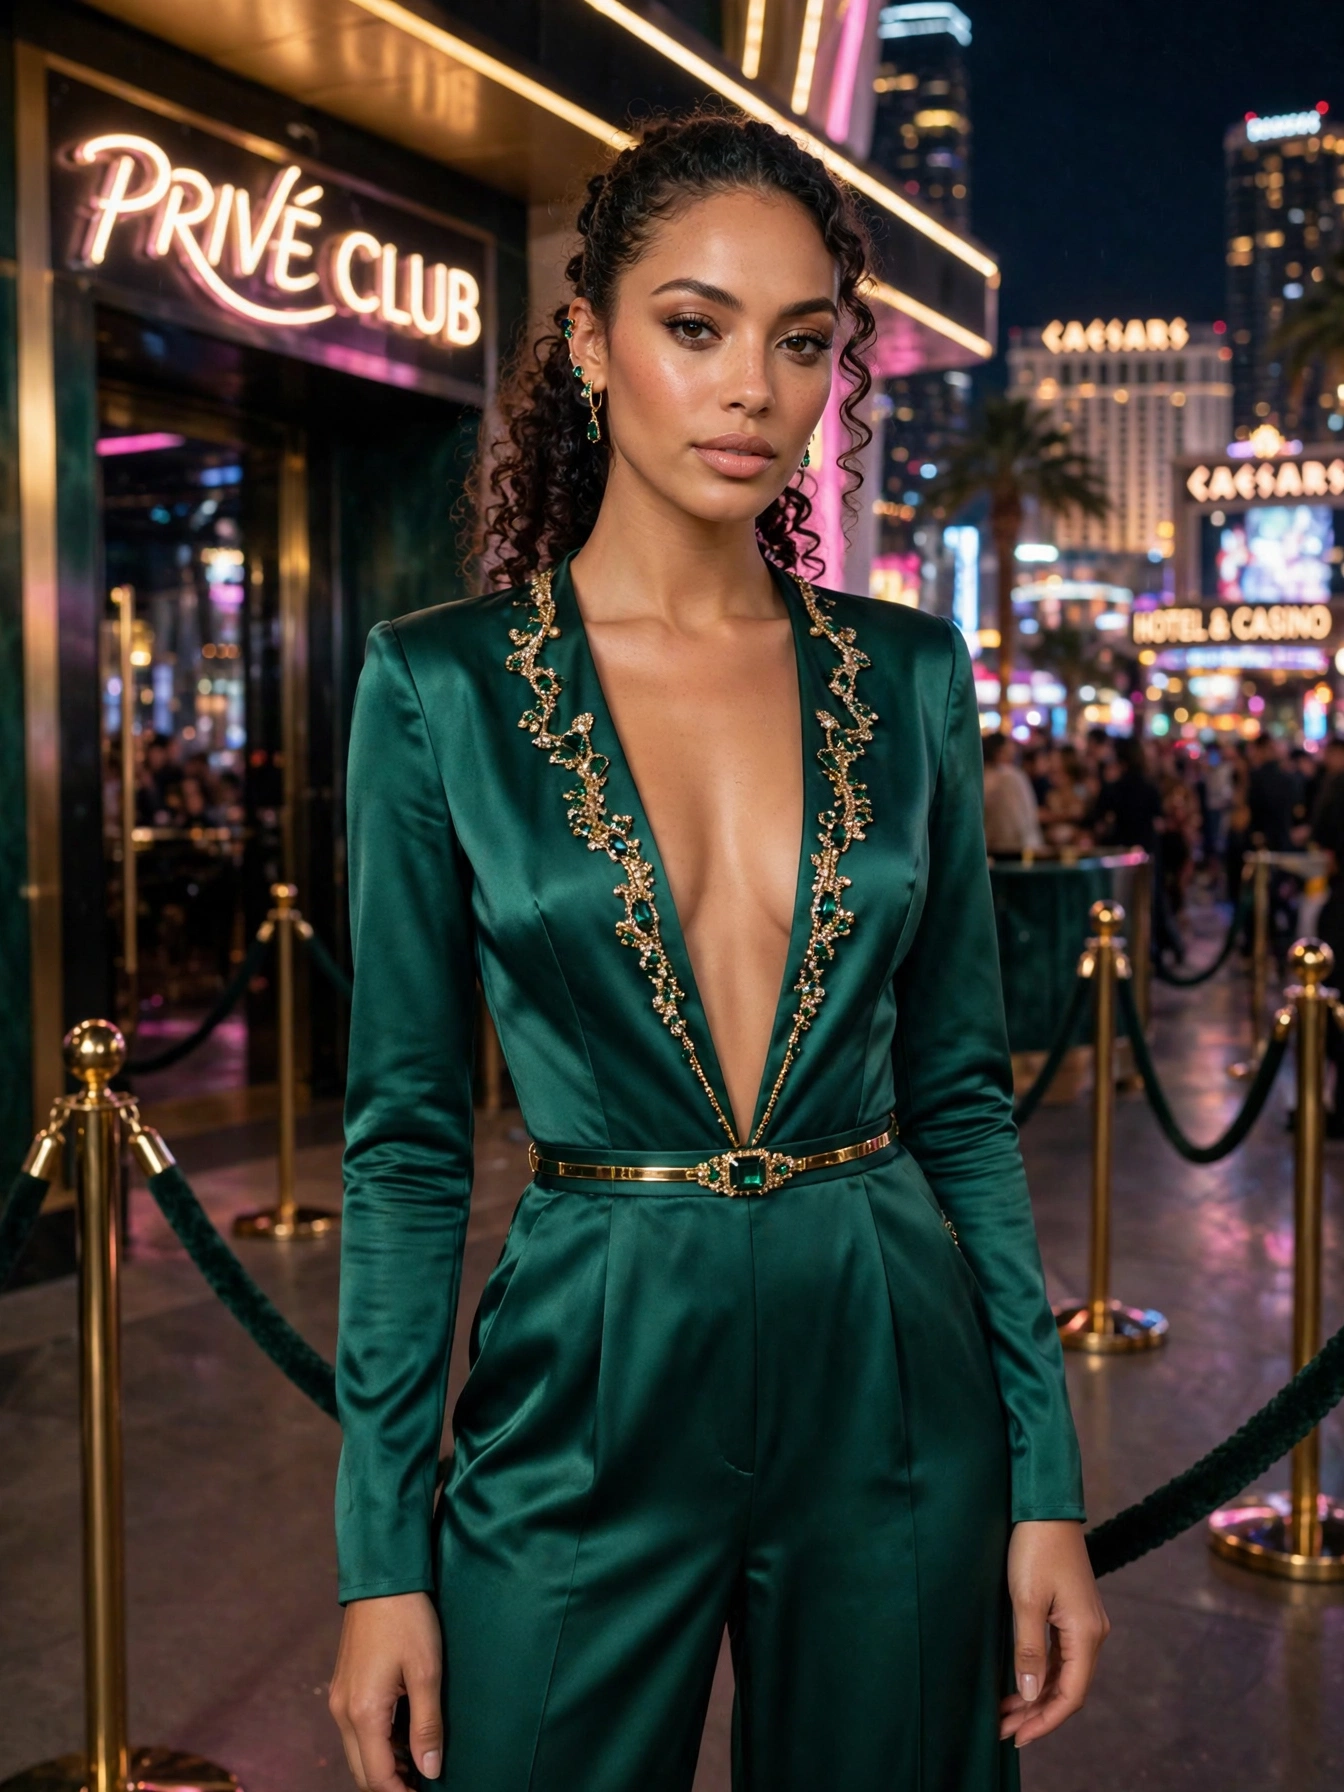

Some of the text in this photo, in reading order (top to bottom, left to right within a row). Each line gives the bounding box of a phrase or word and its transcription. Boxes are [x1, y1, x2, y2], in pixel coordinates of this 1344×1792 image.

[335, 230, 482, 347] CLUB
[1041, 317, 1190, 355] CAESARS
[1186, 458, 1344, 503] CAESARS
[1132, 604, 1332, 644] HOTEL & CASINO
